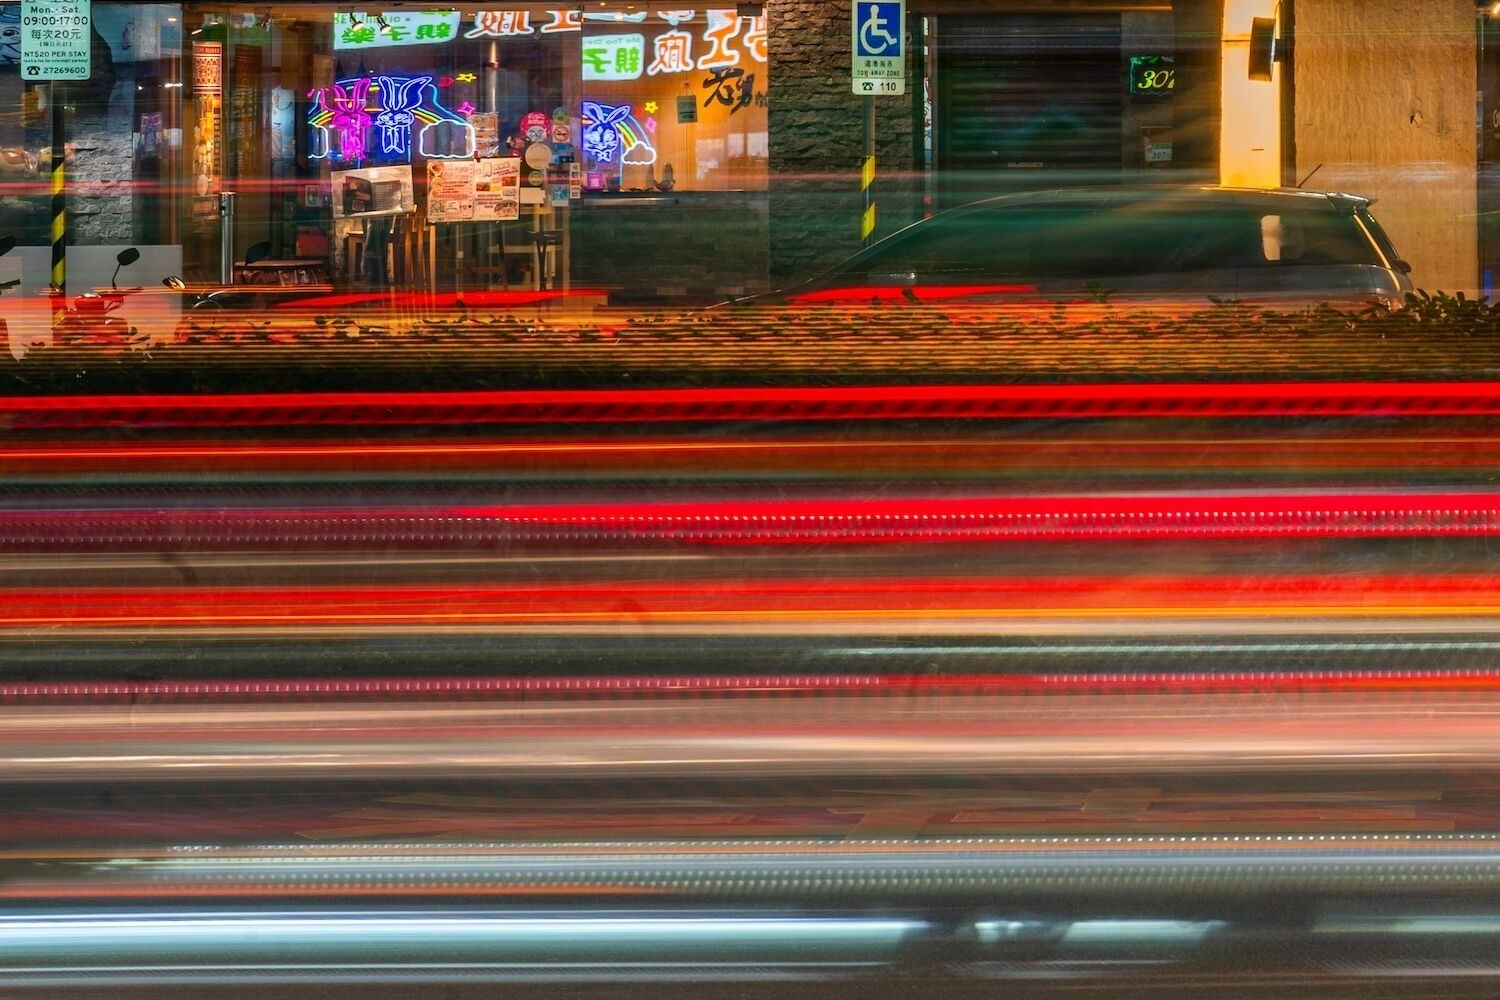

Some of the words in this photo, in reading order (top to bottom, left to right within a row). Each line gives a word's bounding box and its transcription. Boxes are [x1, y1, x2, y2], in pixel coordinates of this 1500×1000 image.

[23, 16, 88, 26] 09:00-17:00
[31, 28, 81, 39] 每次20元
[880, 82, 896, 91] 110
